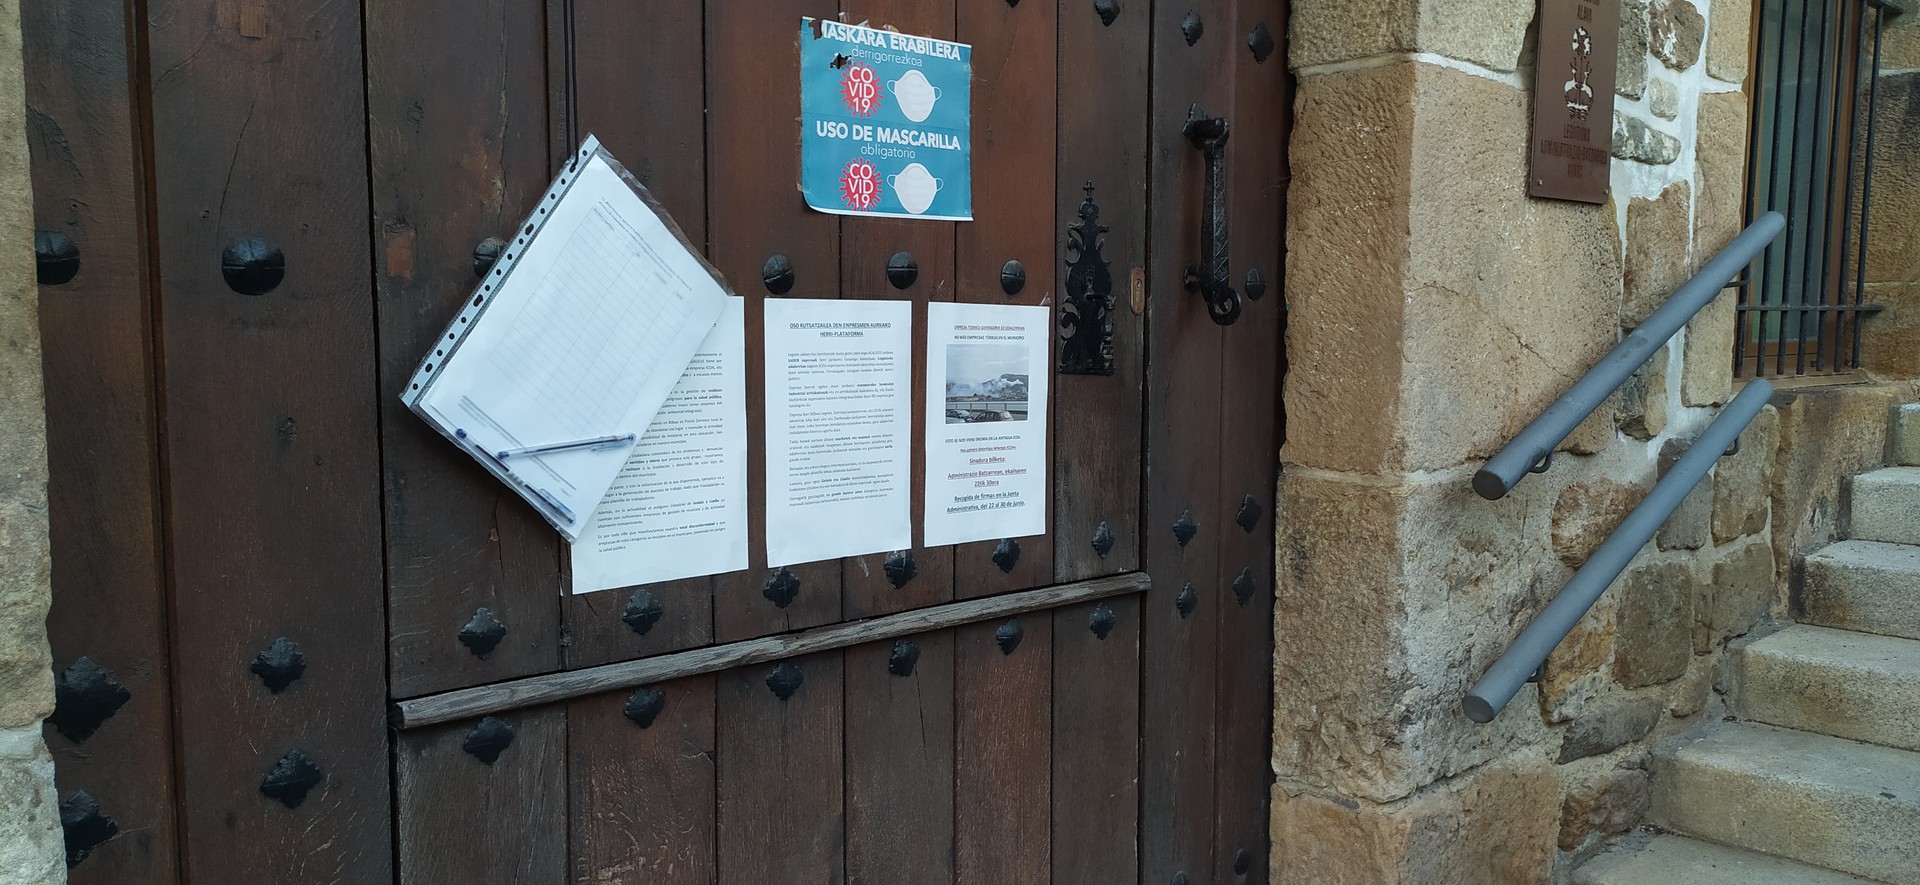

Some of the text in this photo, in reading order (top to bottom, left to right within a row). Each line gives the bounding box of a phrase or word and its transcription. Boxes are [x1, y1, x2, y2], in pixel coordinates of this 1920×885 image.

[890, 33, 961, 61] ERABILERA
[852, 48, 923, 67] derrigorrezkoa
[850, 66, 873, 83] CO
[848, 81, 875, 98] VID
[853, 98, 871, 113] 19
[816, 120, 961, 151] USO DE MASCARILLA
[860, 144, 916, 160] obligatorio
[850, 164, 873, 180] CO
[848, 178, 874, 194] VID
[853, 194, 870, 208] 19
[947, 505, 980, 513] Administrativa,
